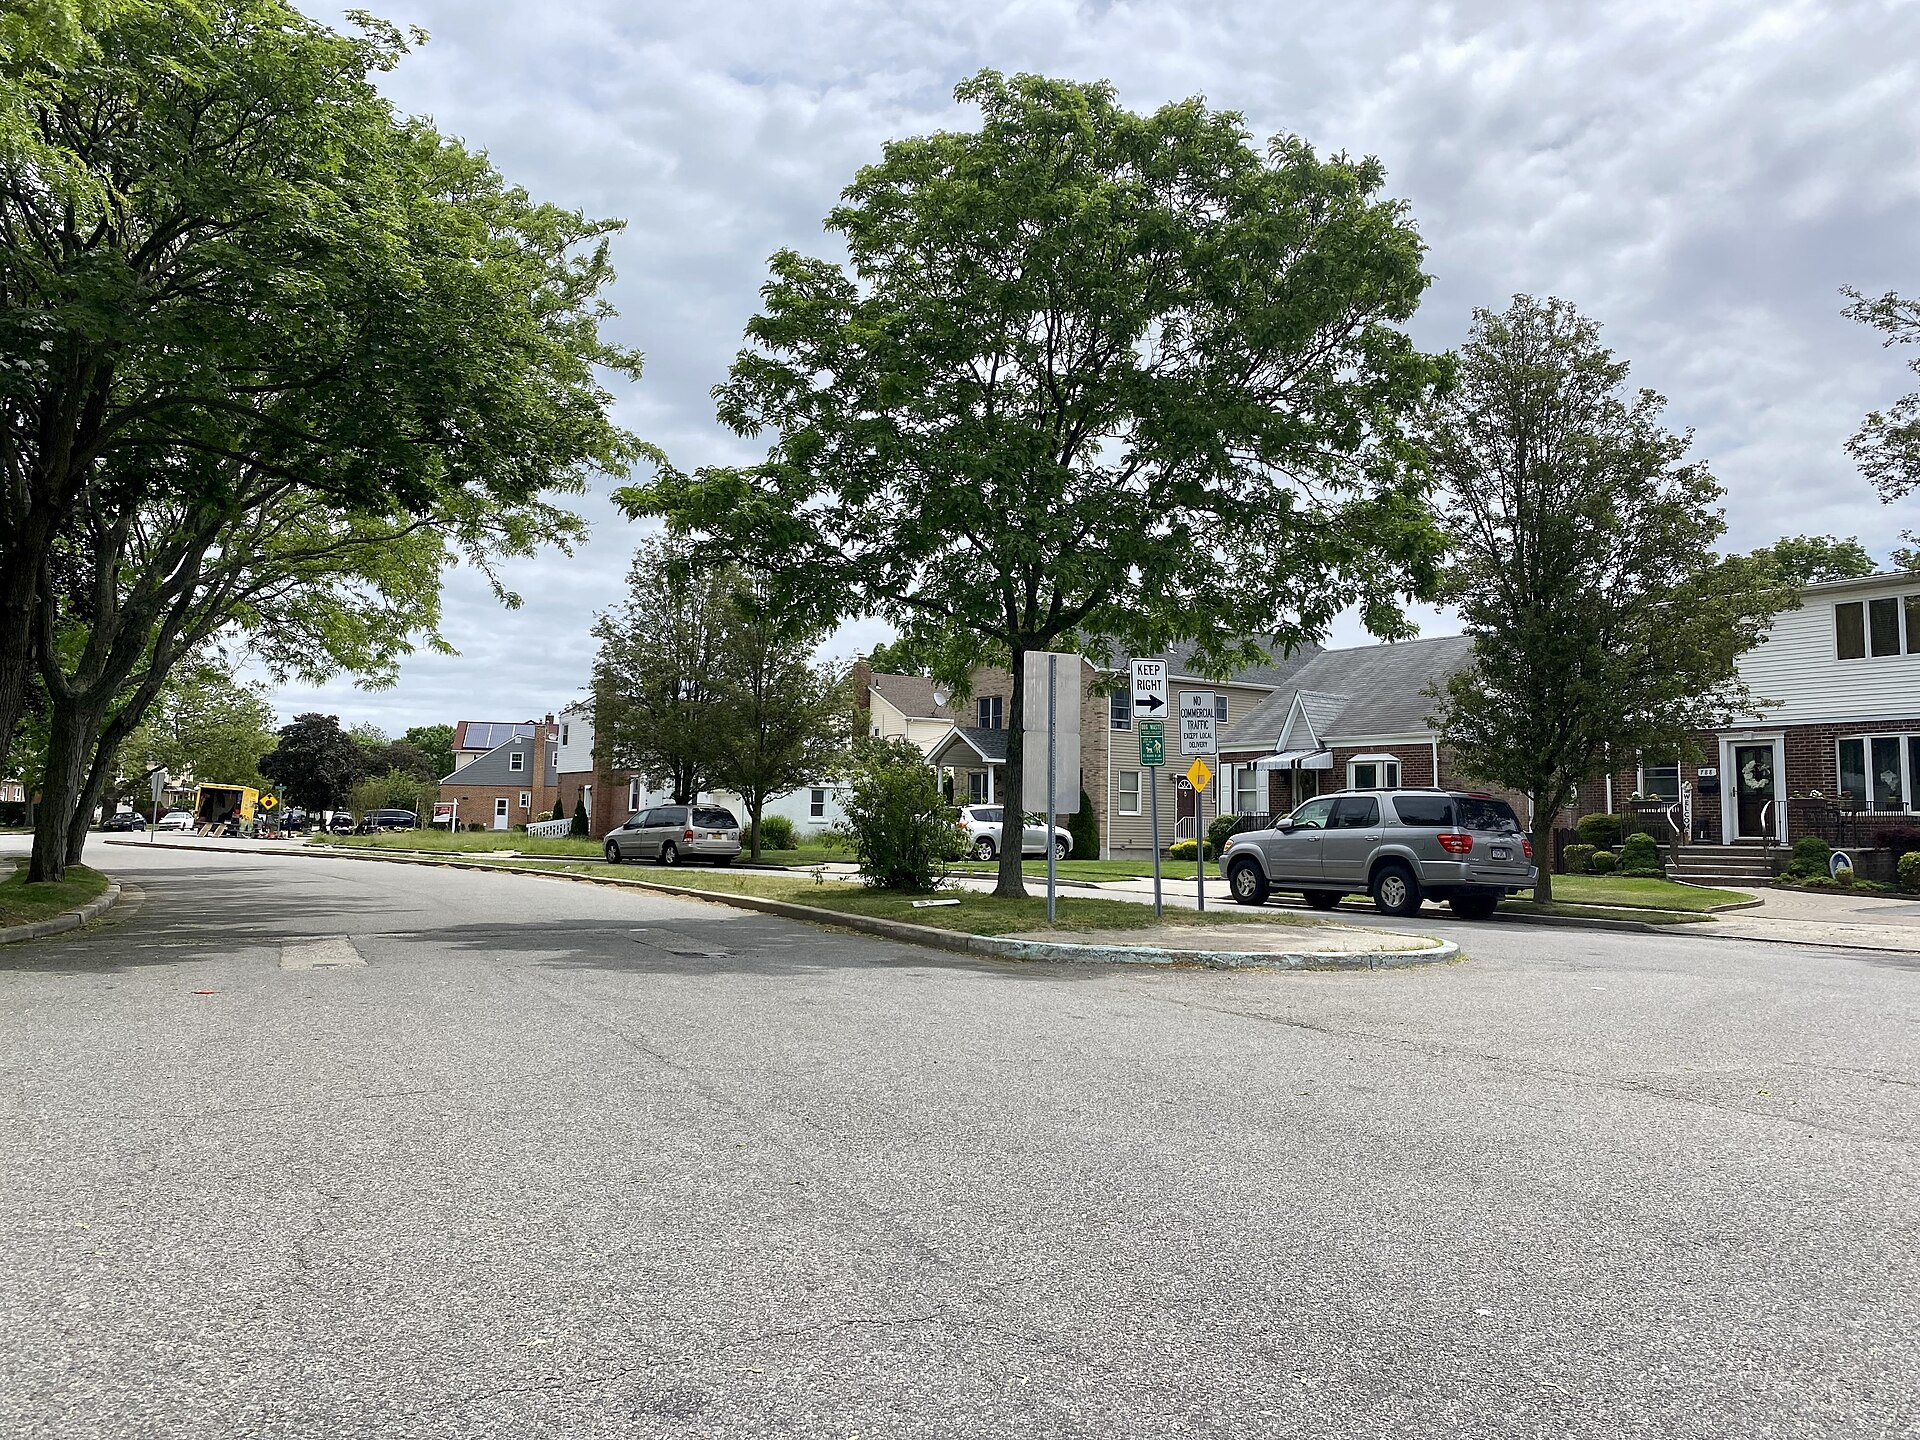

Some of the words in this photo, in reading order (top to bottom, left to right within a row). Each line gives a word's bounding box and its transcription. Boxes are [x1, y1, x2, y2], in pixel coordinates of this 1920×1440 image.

[1137, 664, 1160, 676] KEEP
[1136, 679, 1162, 691] RIGHT
[1193, 696, 1202, 705] NO
[1180, 708, 1214, 719] COMMERCIAL
[1186, 719, 1209, 730] TRAFFIC
